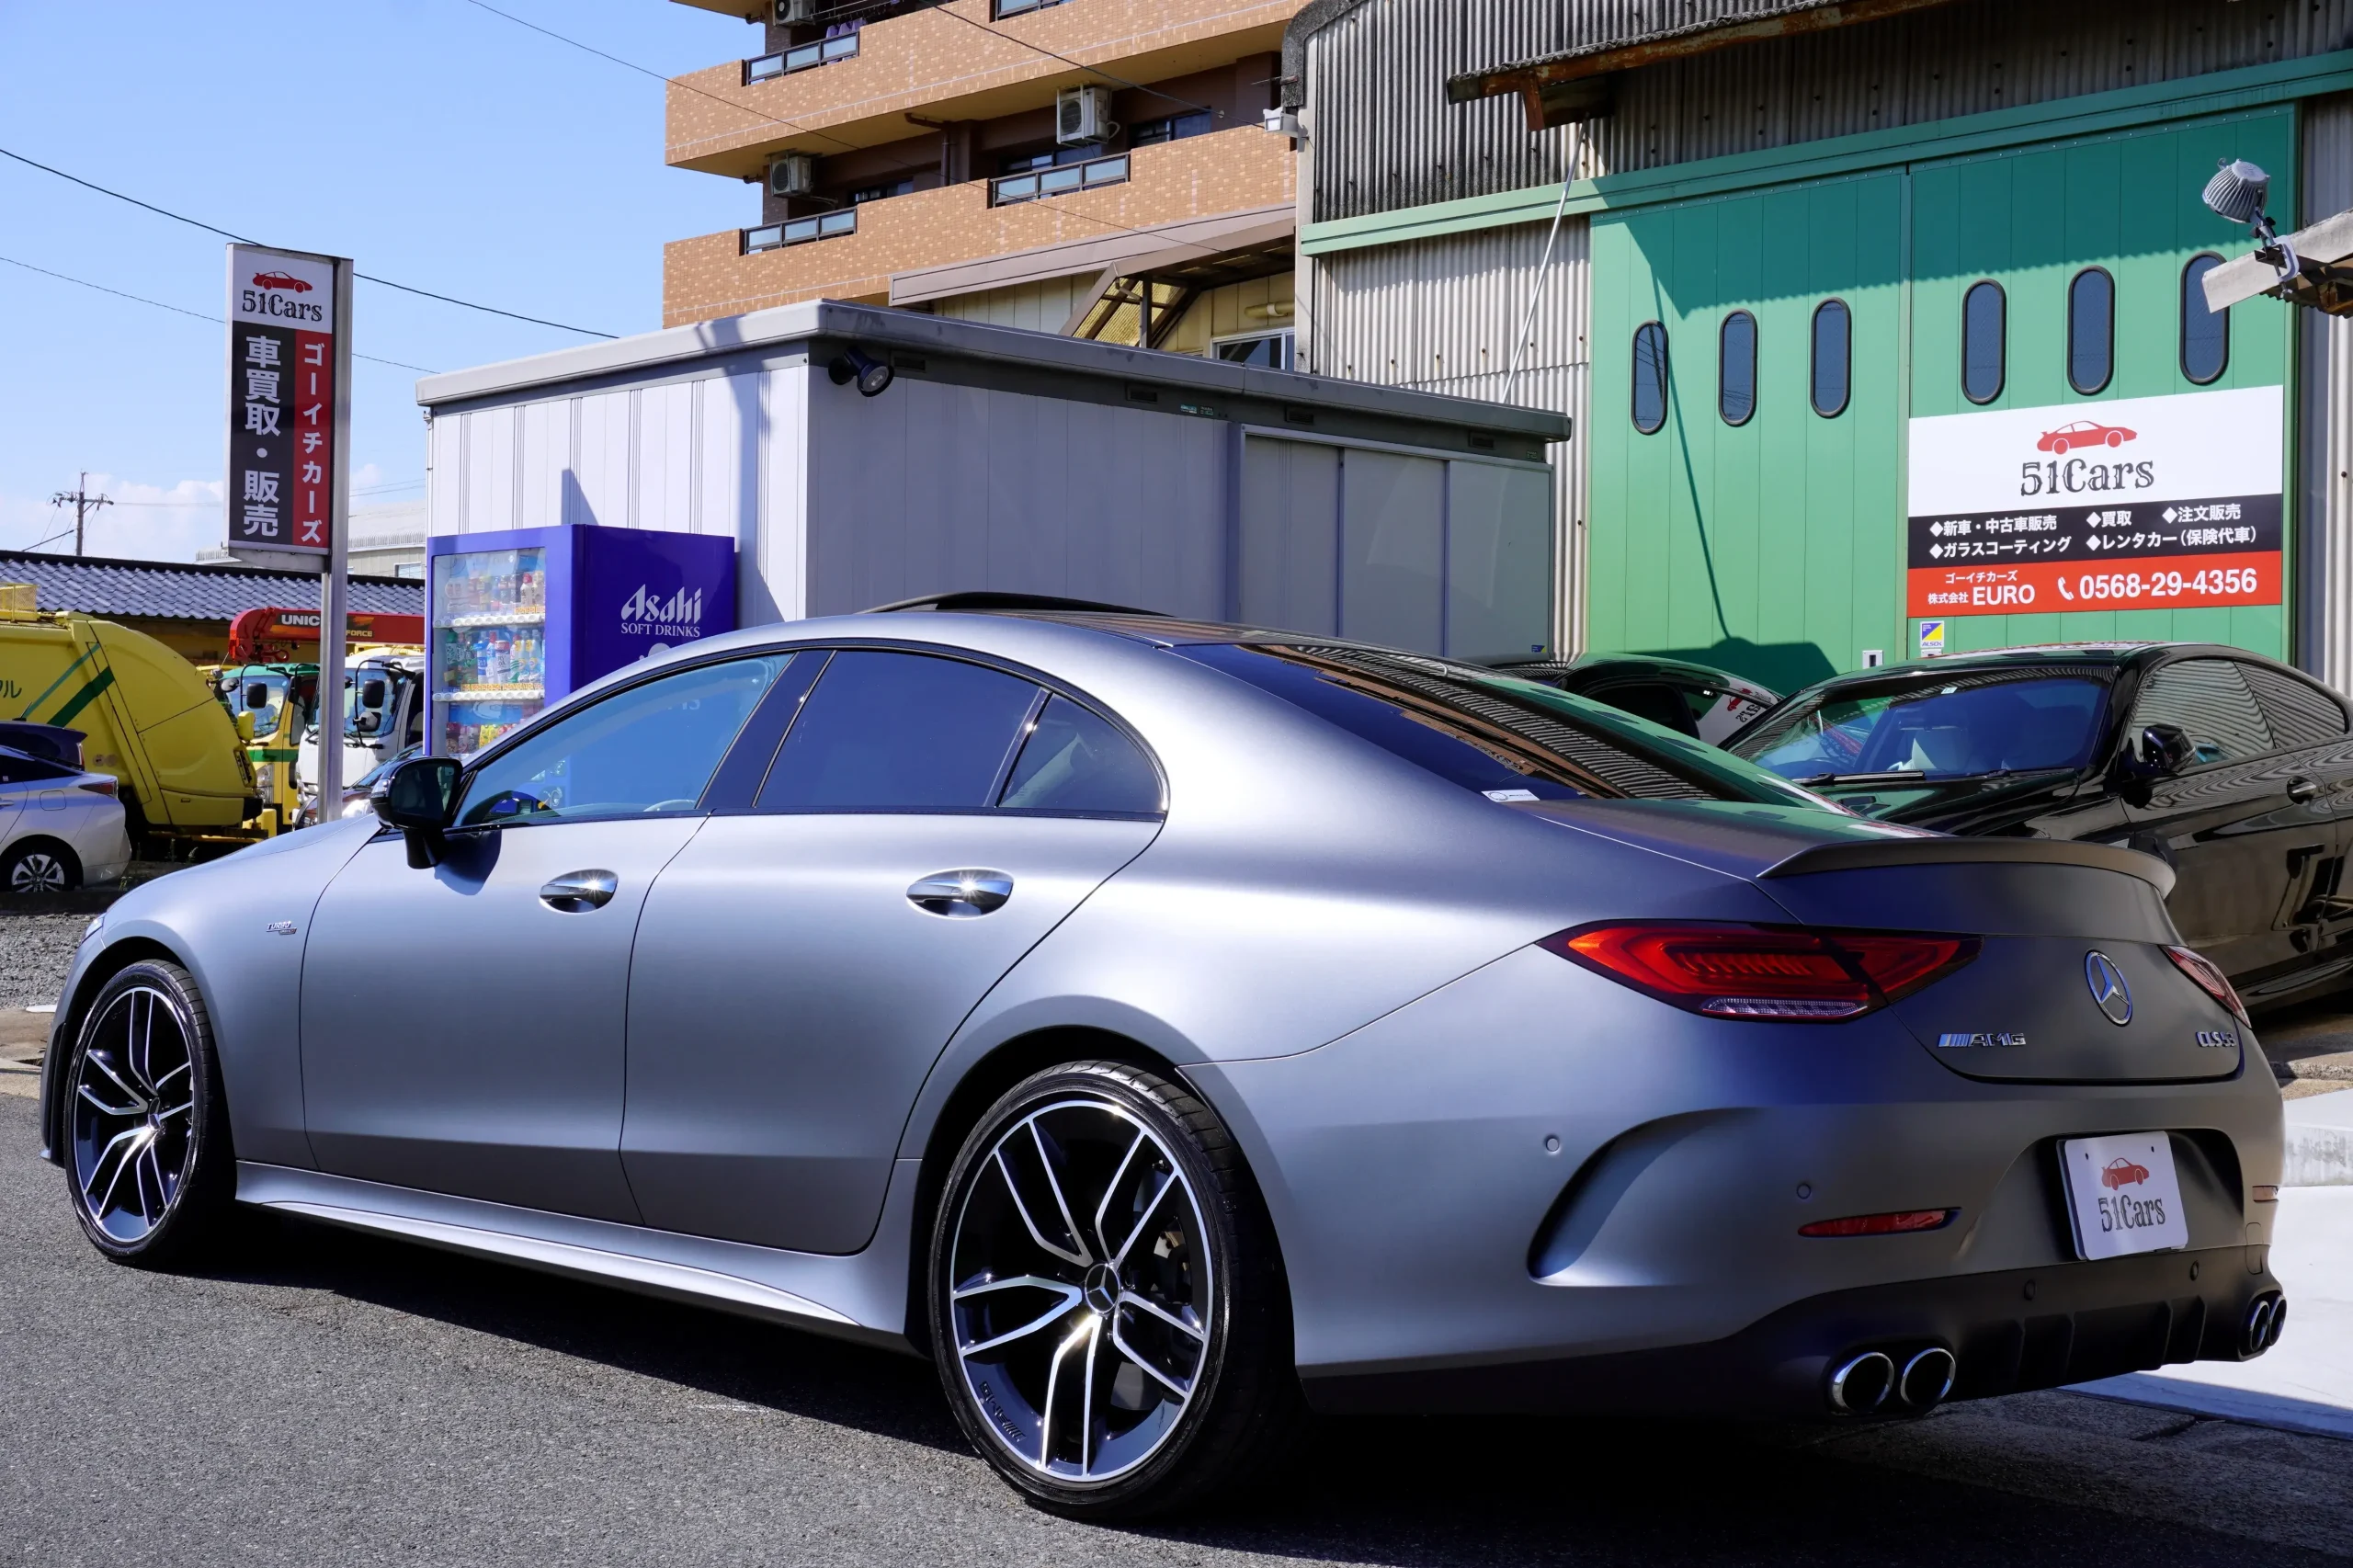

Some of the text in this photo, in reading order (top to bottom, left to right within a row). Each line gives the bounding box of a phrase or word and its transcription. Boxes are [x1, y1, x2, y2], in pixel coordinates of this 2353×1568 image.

[242, 289, 323, 323] 51Cars
[243, 335, 281, 537] 車買取・販売
[301, 343, 325, 543] ゴーイチカーズ
[2021, 459, 2154, 496] 51Cars
[2101, 510, 2132, 528] 買取
[2177, 503, 2242, 523] 注文販売
[1943, 515, 2057, 537] 新車・中古車販売
[1943, 536, 2072, 558] ガラスコーティング
[1945, 570, 2018, 584] ゴーイチカーズ
[2079, 568, 2257, 599] 0568-29-4356
[620, 584, 701, 624] Asahi
[1927, 584, 2035, 606] 株式会社 EURO
[281, 614, 320, 626] UNIC
[620, 622, 700, 638] SOFT DRINKS
[1968, 1033, 2026, 1047] AMG
[2097, 1194, 2165, 1233] 51Cars
